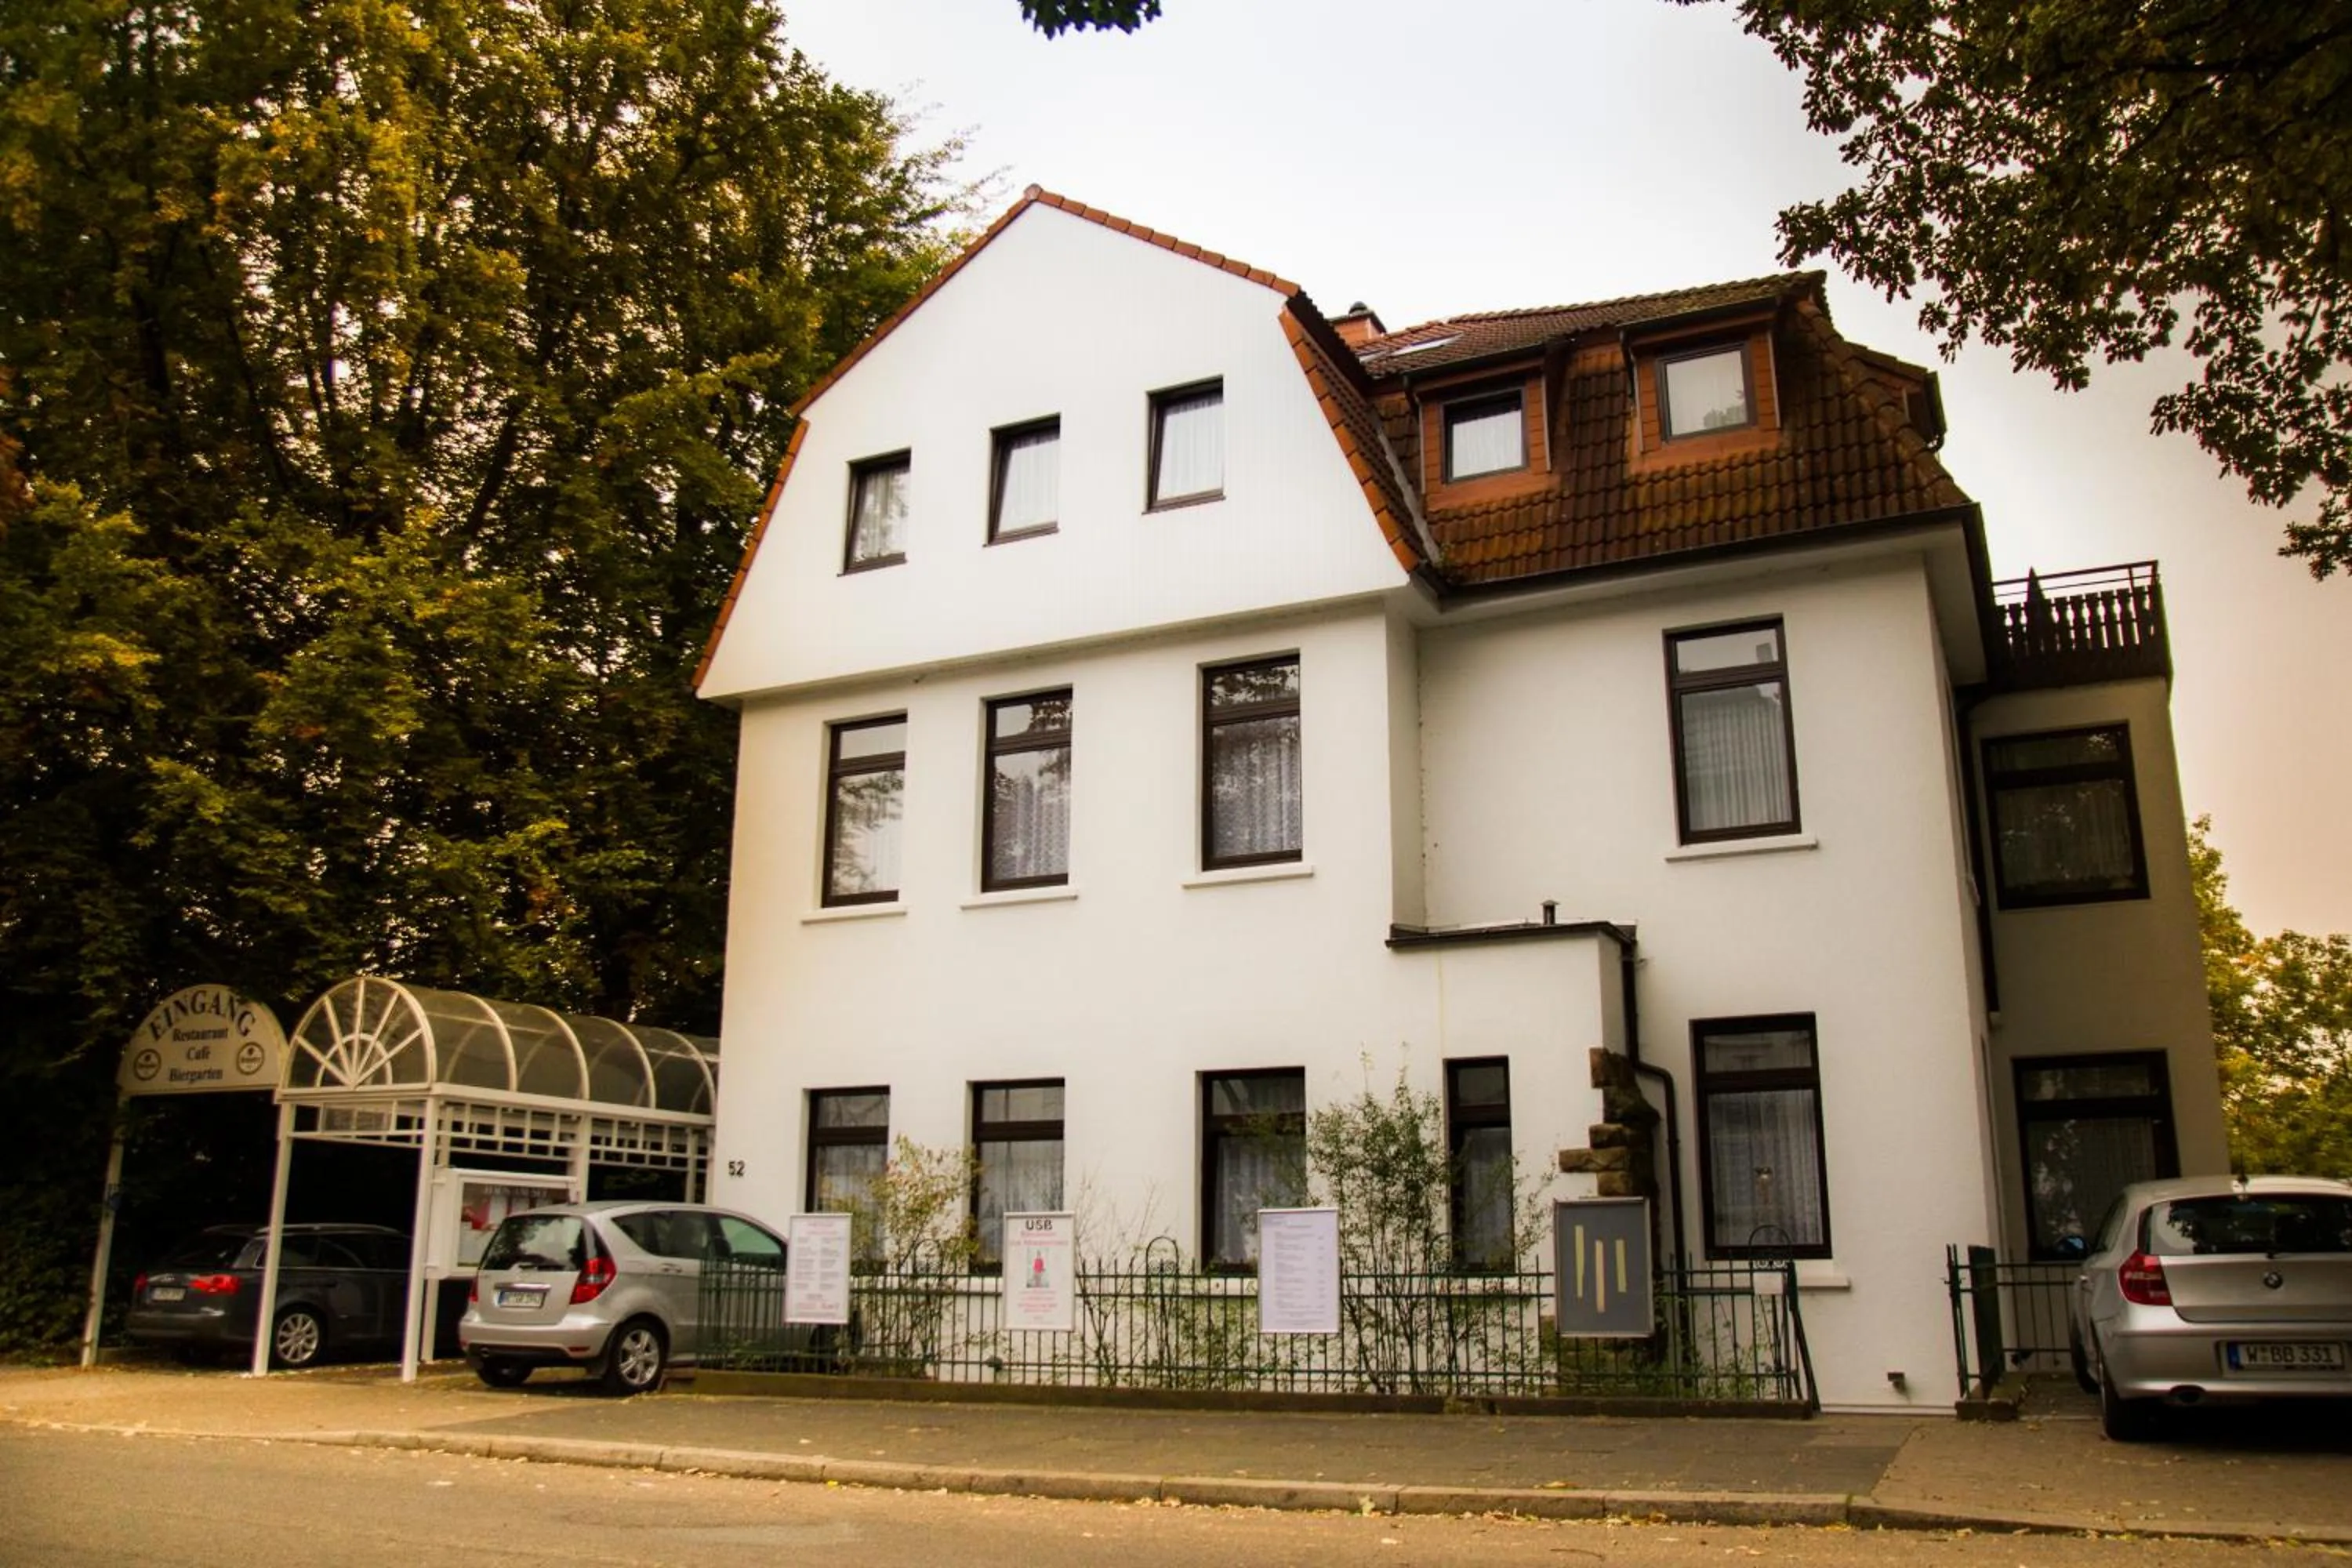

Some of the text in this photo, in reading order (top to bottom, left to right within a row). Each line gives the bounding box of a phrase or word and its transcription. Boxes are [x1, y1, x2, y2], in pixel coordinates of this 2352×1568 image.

[149, 989, 256, 1042] EINGANG
[172, 1027, 229, 1042] Restaurant
[169, 1067, 223, 1083] Biergarten
[728, 1160, 745, 1177] 52
[2245, 1345, 2333, 1363] W BB 331
